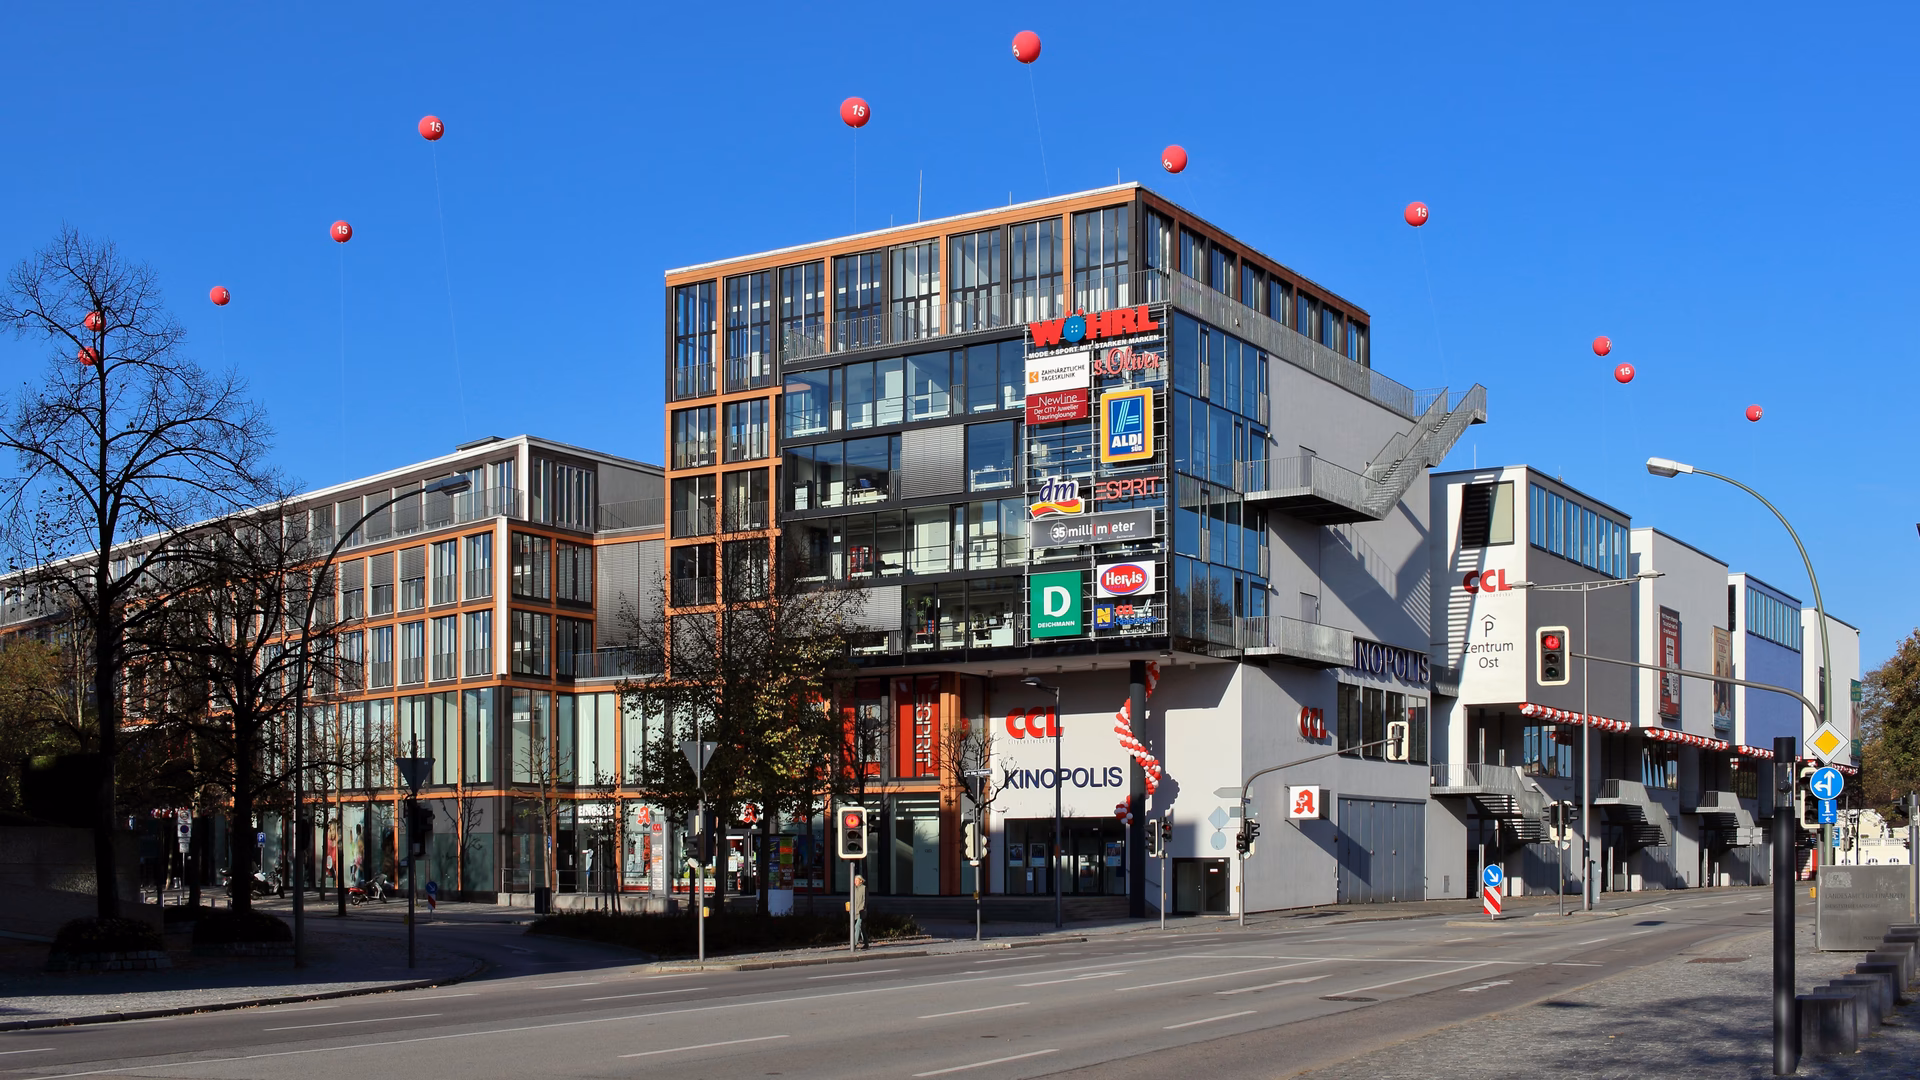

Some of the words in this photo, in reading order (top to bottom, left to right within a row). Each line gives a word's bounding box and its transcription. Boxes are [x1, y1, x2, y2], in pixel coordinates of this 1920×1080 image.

[852, 104, 865, 117] 15
[430, 121, 441, 133] 15
[1415, 207, 1427, 218] 15
[336, 225, 348, 235] 15
[1029, 304, 1159, 348] WÖHRL
[1028, 351, 1049, 360] MODE
[1055, 346, 1078, 355] SPORT
[1094, 339, 1127, 349] STARKEN
[1128, 334, 1160, 344] MARKEN
[1094, 346, 1160, 376] s.Oliver
[1041, 364, 1086, 376] ZAHNÄRZTLICHE
[1041, 372, 1076, 382] TAGESKLINIK
[1620, 367, 1631, 376] 15
[1038, 393, 1077, 407] NewLine
[1037, 411, 1077, 421] Trauringlounge
[1044, 406, 1056, 414] CITY
[1057, 404, 1079, 413] Juwelier
[1112, 433, 1142, 448] ALDI
[1039, 477, 1075, 502] dm
[1095, 476, 1160, 501] ESPRIT
[1052, 526, 1066, 538] 35
[1105, 570, 1143, 588] Hervis
[1462, 568, 1513, 595] CCL
[1043, 586, 1072, 618] D
[1037, 620, 1075, 629] DEICHMANN
[1463, 641, 1514, 655] Zentrum
[1478, 656, 1499, 669] Ost
[1005, 705, 1065, 740] CCL
[1300, 706, 1328, 739] CCL
[916, 693, 933, 767] ESPRIT
[1005, 766, 1123, 790] KINOPOLIS
